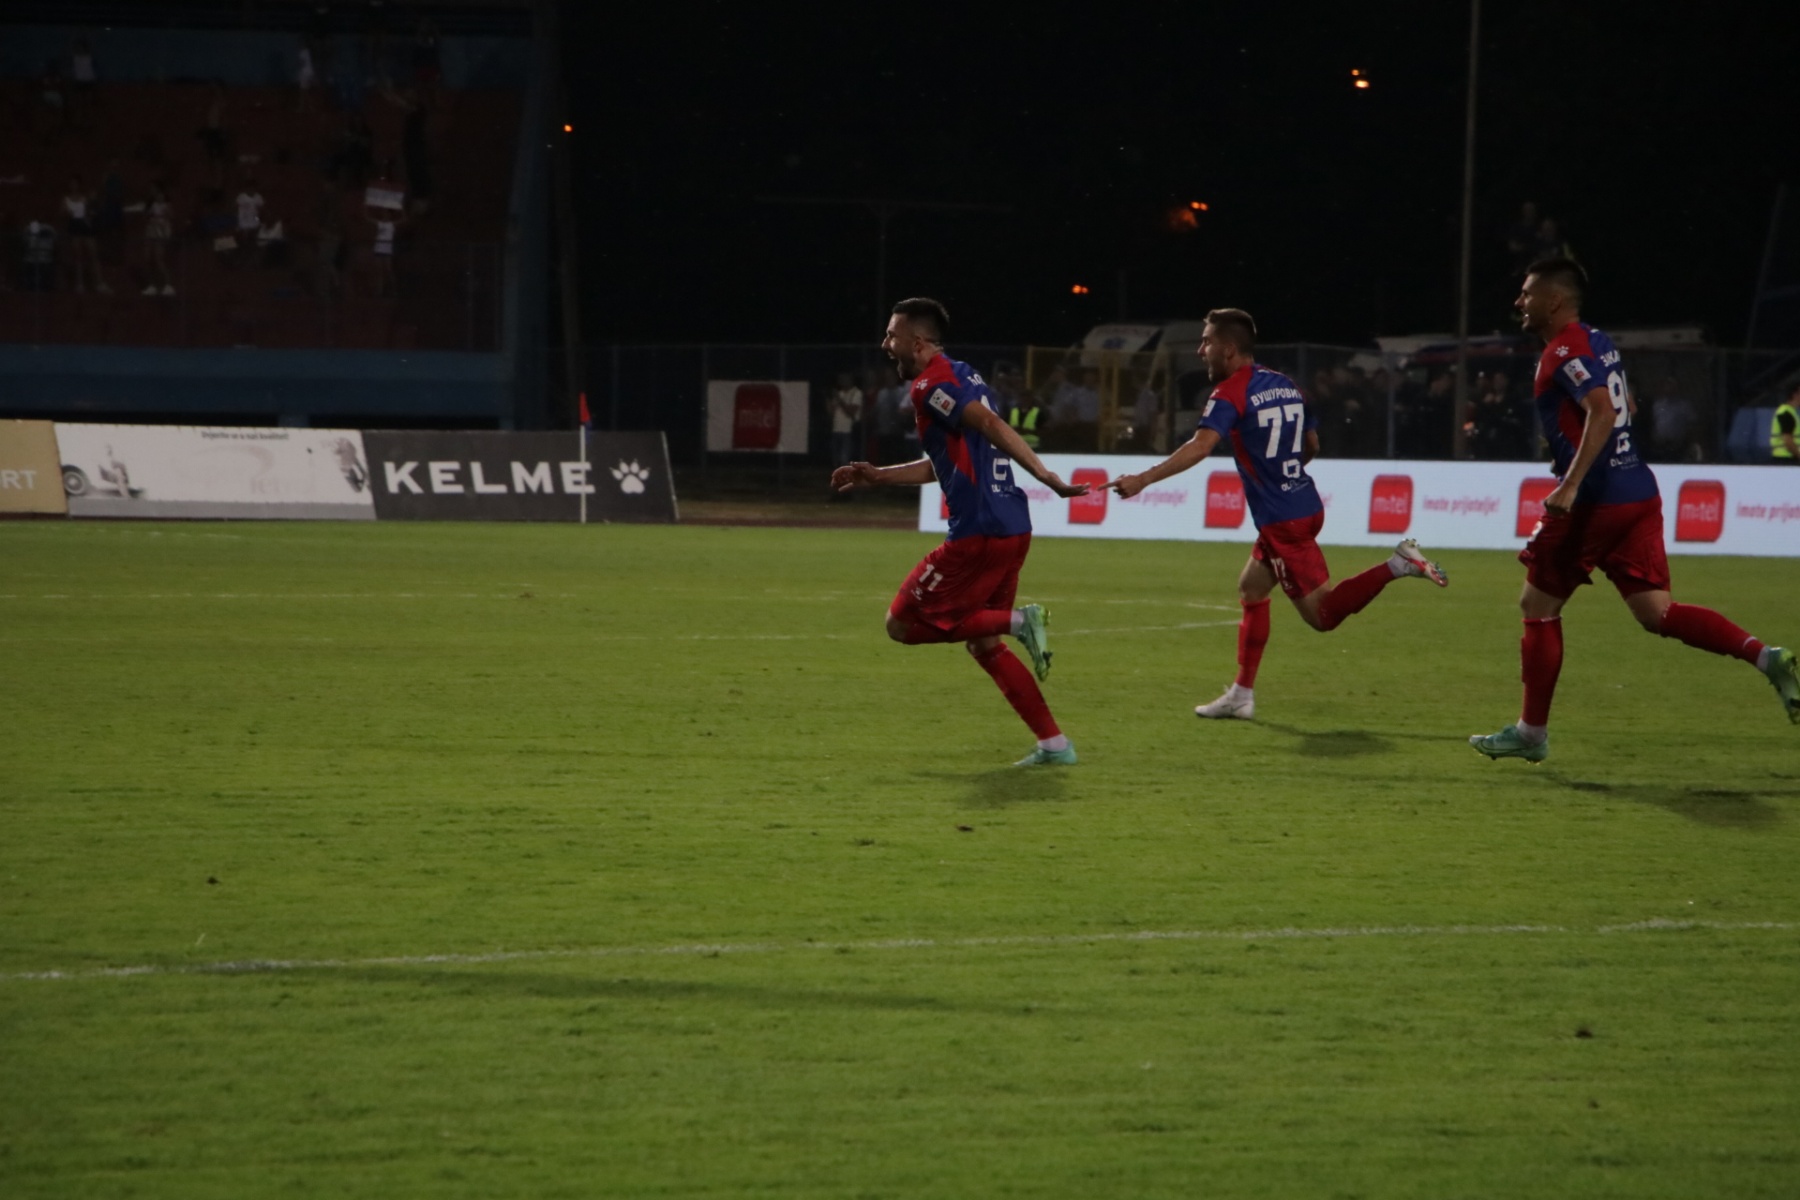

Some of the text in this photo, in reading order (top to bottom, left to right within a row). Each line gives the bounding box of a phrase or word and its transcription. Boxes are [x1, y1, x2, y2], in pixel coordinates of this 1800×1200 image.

[1257, 403, 1305, 459] 77
[383, 461, 596, 494] KELME
[919, 564, 944, 591] 11
